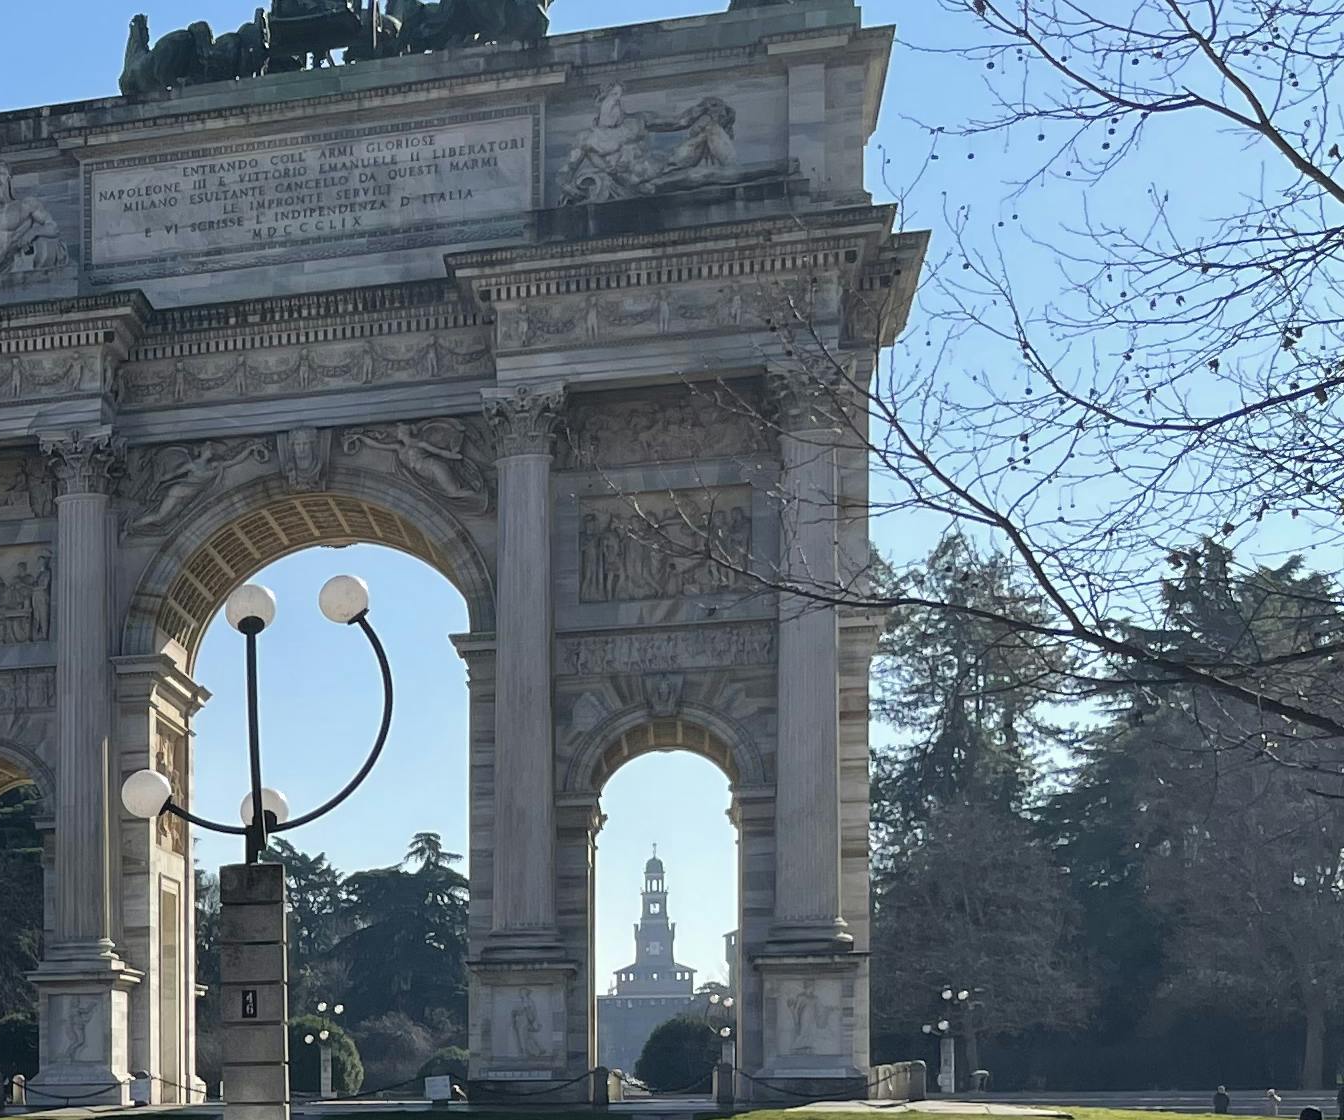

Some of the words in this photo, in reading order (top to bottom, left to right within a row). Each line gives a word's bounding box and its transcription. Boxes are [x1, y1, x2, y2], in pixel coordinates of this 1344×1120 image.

[98, 182, 182, 202] NAPOLEONE
[192, 178, 207, 190] III
[218, 175, 226, 187] E
[238, 165, 308, 184] VITTORIO
[318, 154, 399, 174] EMANUELE
[410, 151, 421, 162] II
[432, 137, 526, 160] LIBERATORI
[182, 158, 259, 178] ENTRANDO
[319, 145, 355, 160] ARMI
[366, 135, 436, 154] GLORIOSE
[123, 196, 179, 213] MILANO
[189, 186, 265, 205] ESULTANTE
[275, 175, 349, 193] CANCELLO
[359, 172, 377, 184] DA
[387, 163, 440, 181] QUESTI
[449, 156, 499, 172] MARMI
[223, 202, 239, 215] LE
[249, 192, 323, 212] IMPRONTE
[336, 183, 392, 201] SERVILI
[144, 227, 152, 238] E
[164, 222, 179, 236] VI
[190, 216, 244, 233] SCRISSE
[274, 200, 388, 223] INDIPENDENZA
[422, 188, 474, 205] ITALIA
